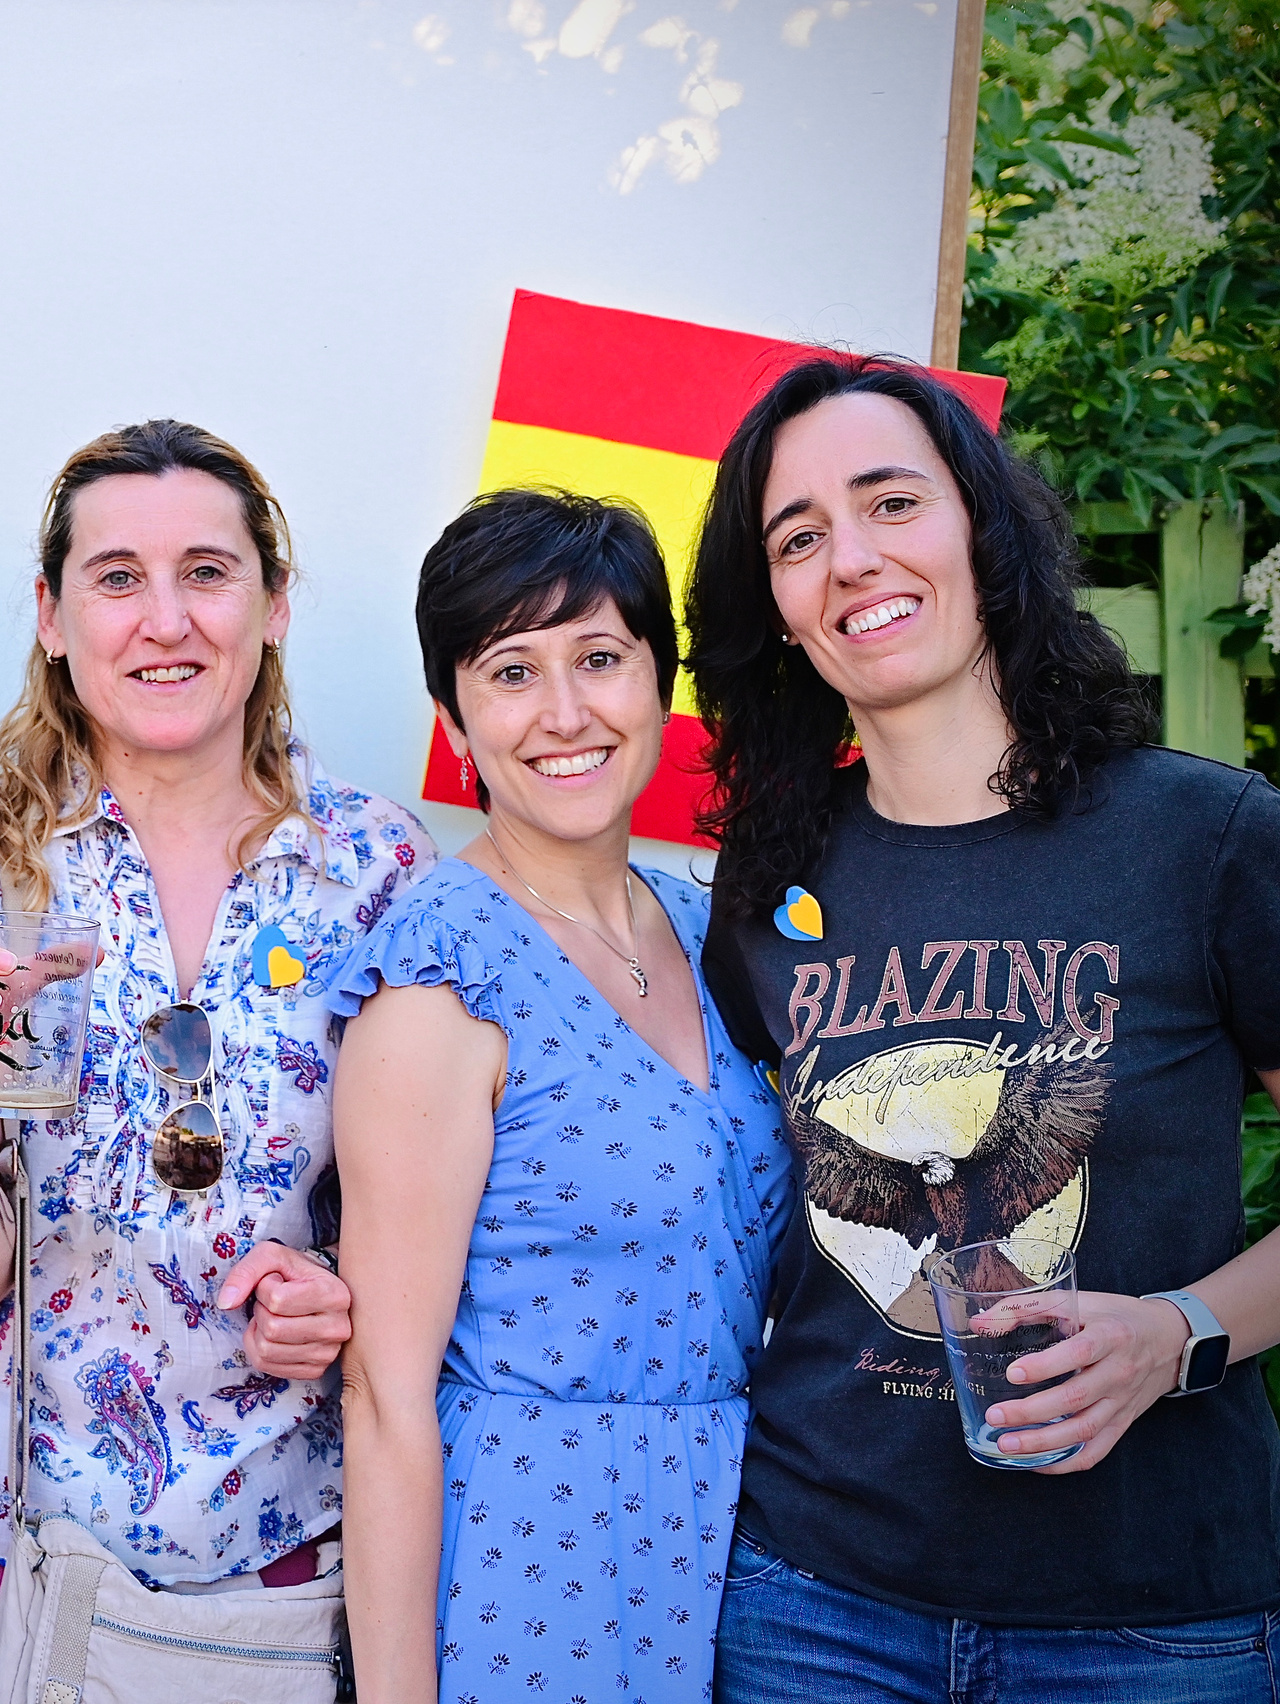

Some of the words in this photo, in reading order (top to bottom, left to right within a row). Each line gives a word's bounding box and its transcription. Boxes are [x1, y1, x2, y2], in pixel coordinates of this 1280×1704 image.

[785, 940, 1120, 1056] BLAZING
[784, 1032, 1110, 1125] Independence
[978, 1327, 1011, 1339] Feria
[854, 1348, 942, 1395] Riding
[882, 1381, 933, 1399] FLYING
